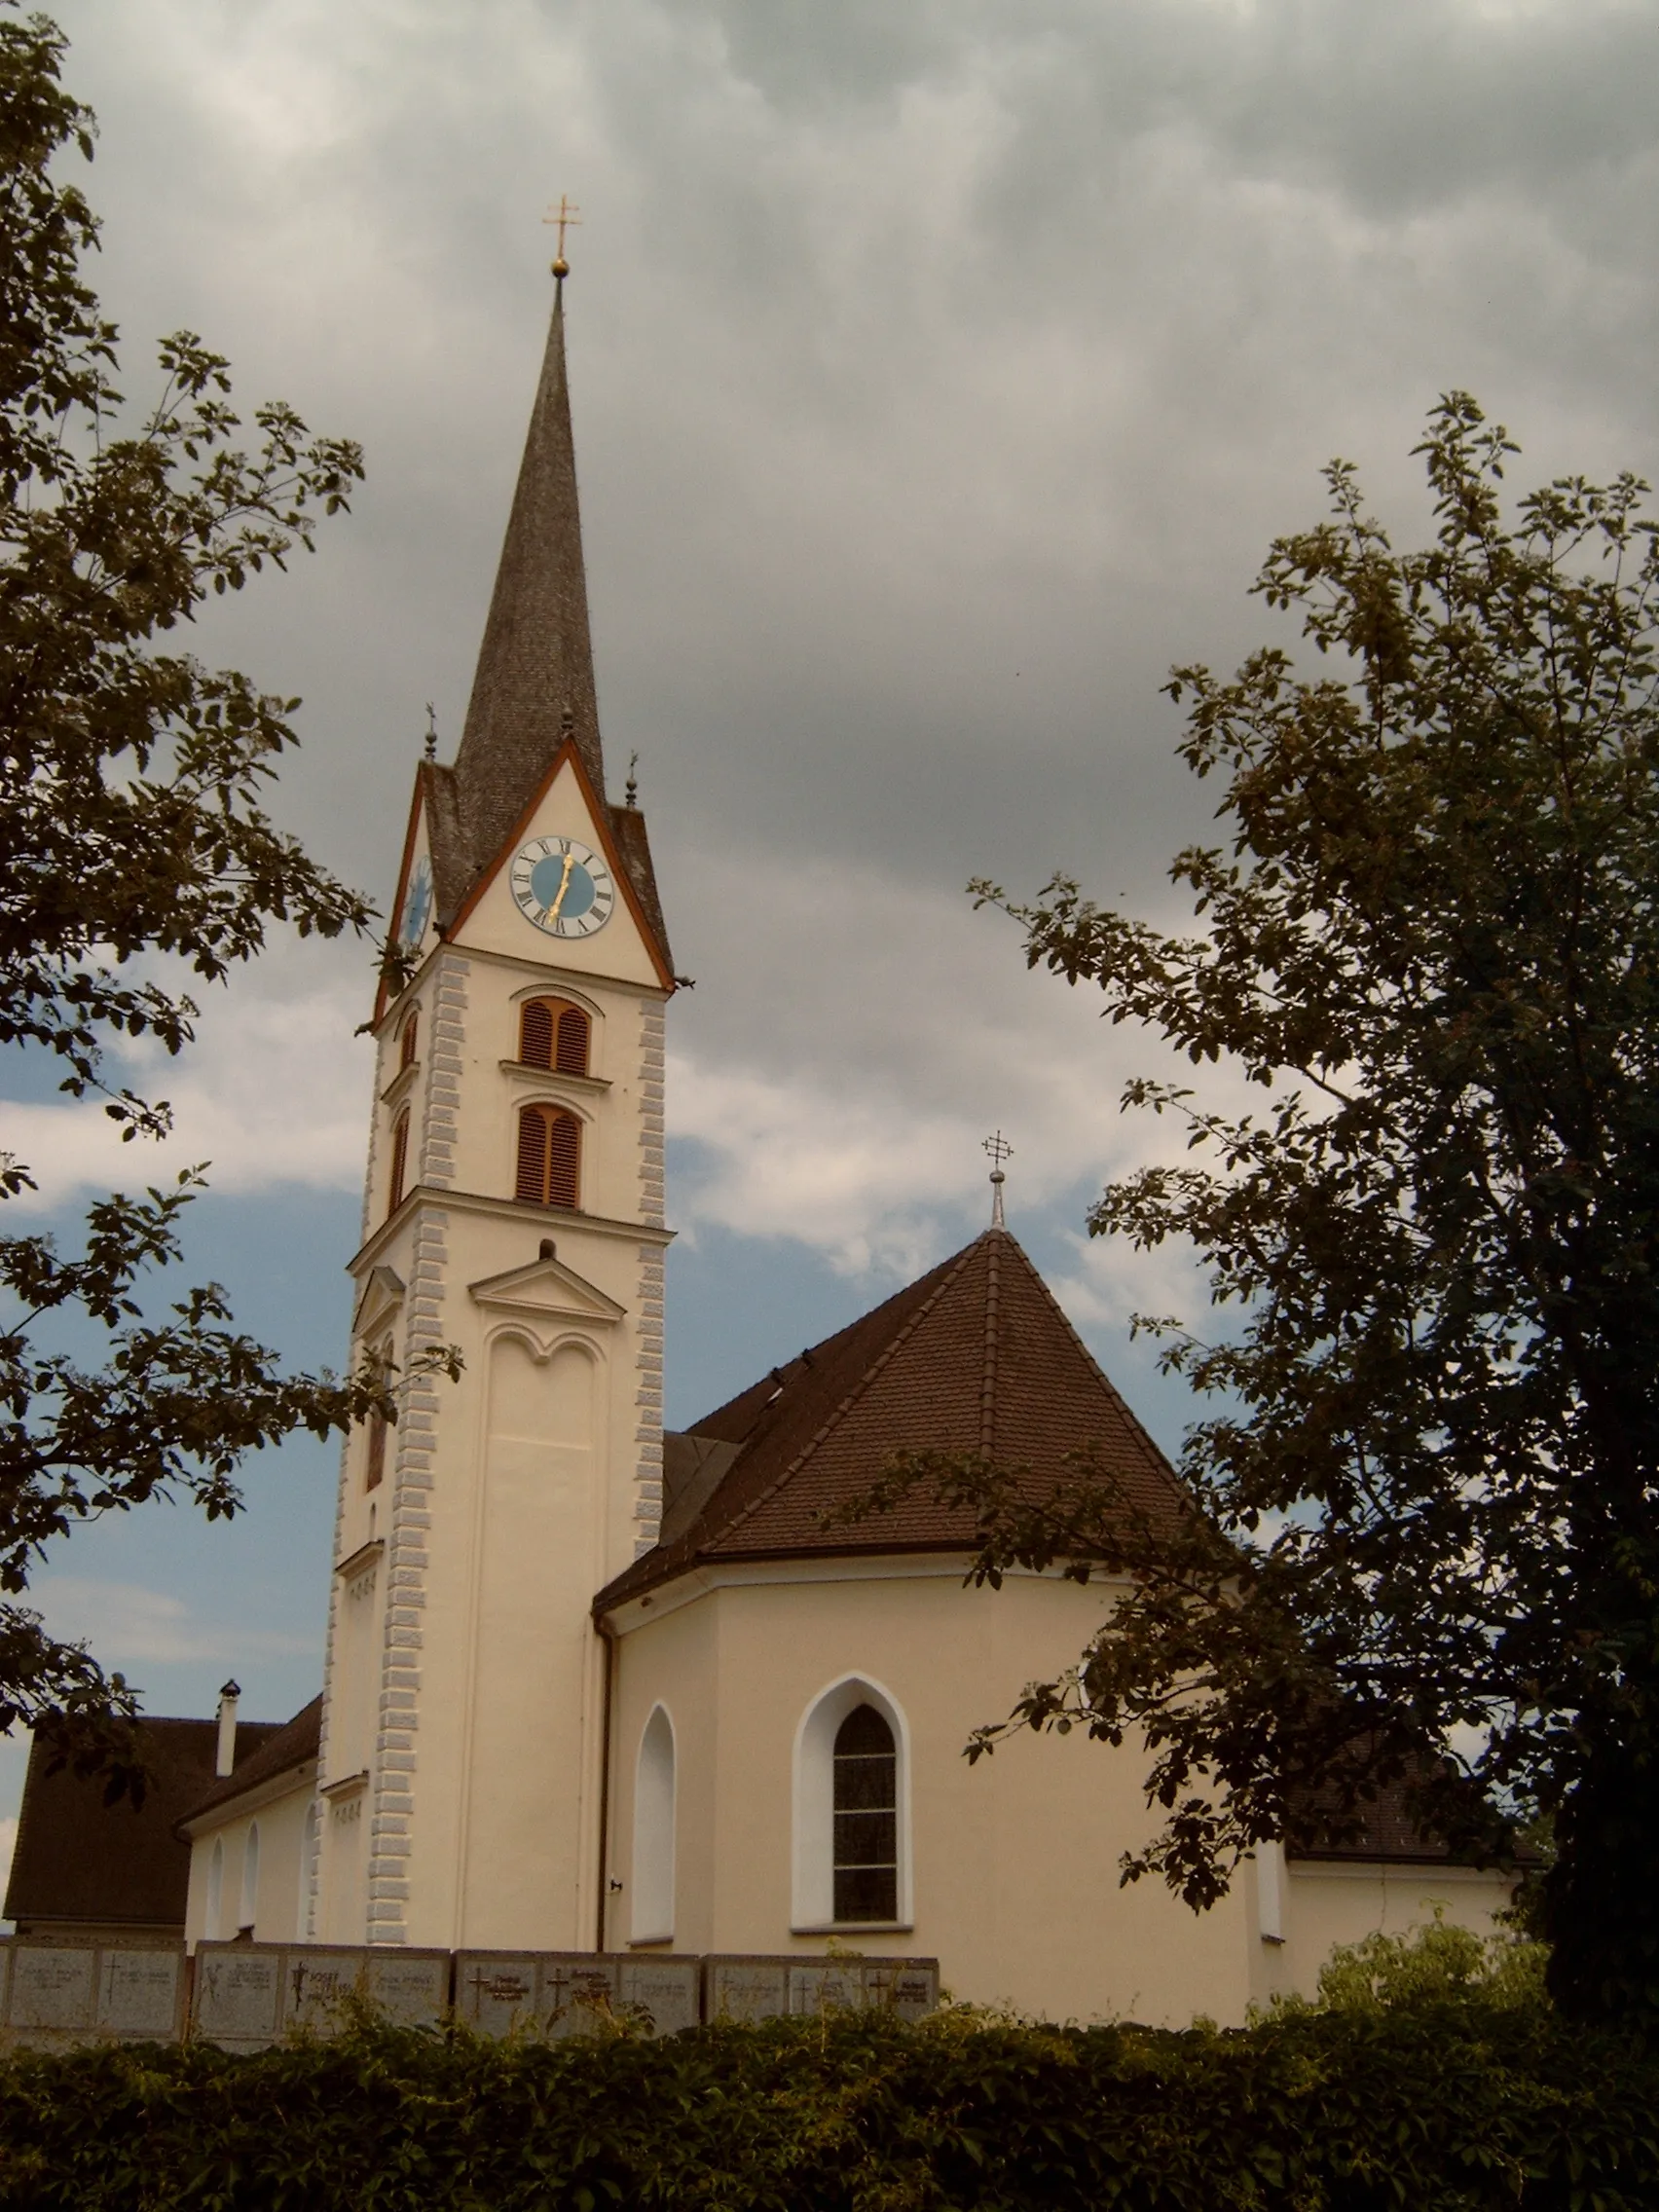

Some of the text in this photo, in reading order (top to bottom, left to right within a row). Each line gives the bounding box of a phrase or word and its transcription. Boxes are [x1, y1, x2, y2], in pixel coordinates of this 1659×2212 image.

[537, 839, 551, 855] XI
[559, 839, 571, 855] XII
[518, 851, 536, 866] X
[582, 854, 594, 865] I
[513, 871, 530, 883] IX
[596, 891, 611, 902] III
[556, 918, 566, 934] VI
[577, 918, 589, 934] V
